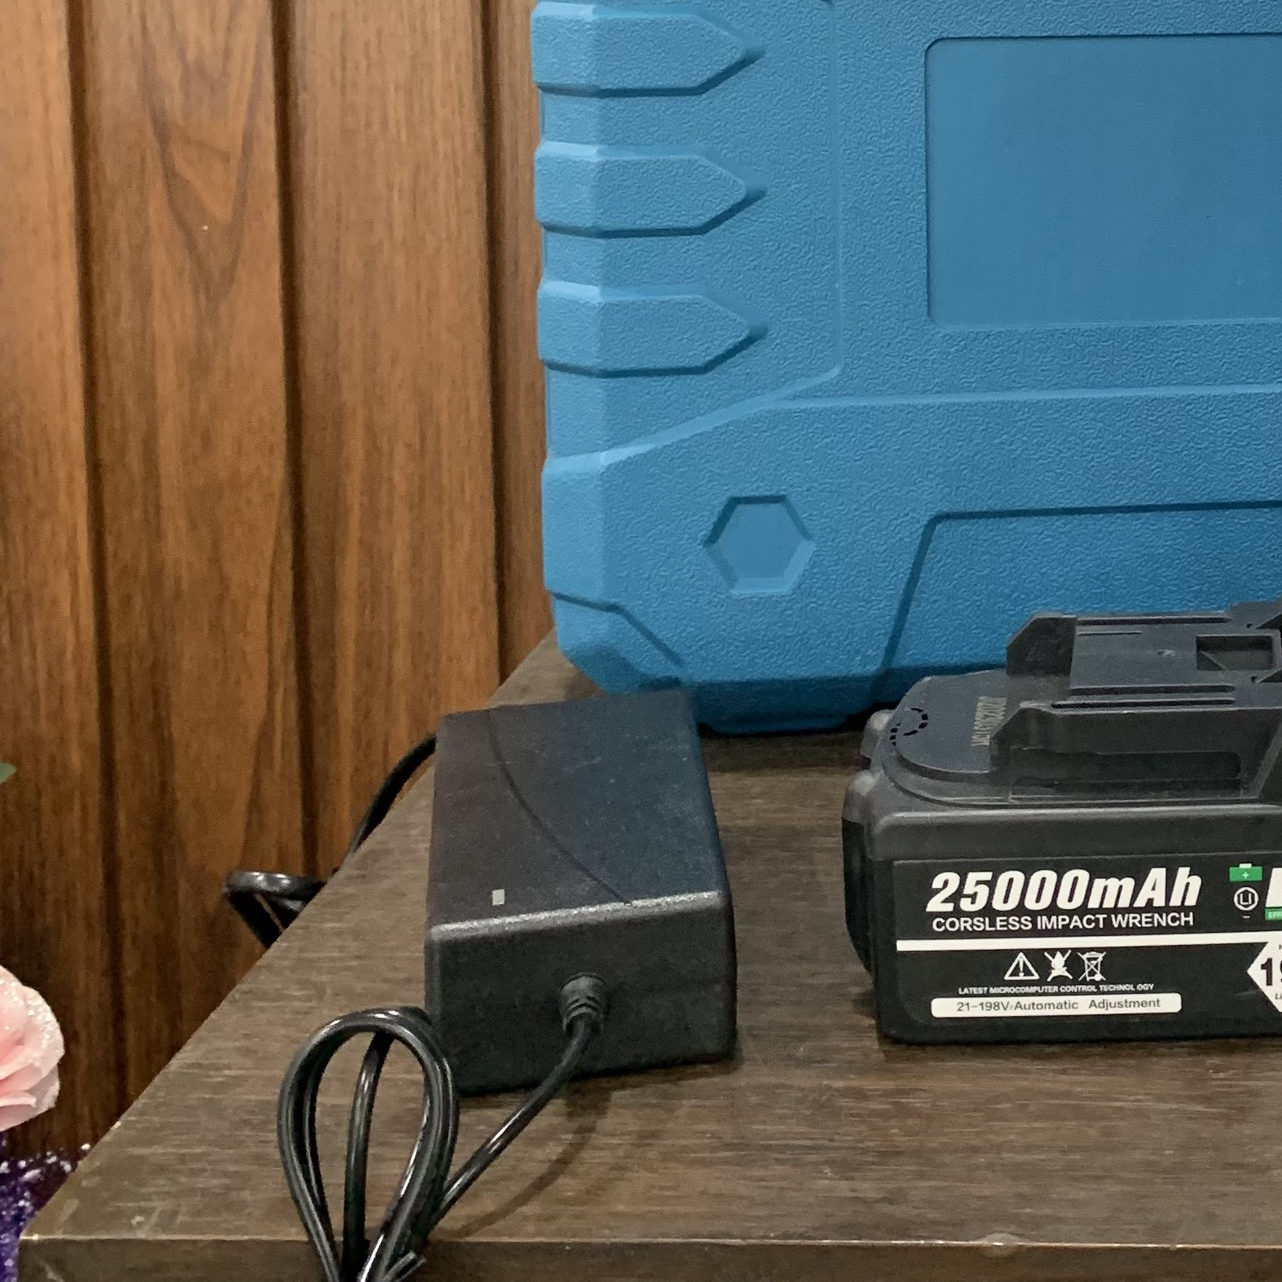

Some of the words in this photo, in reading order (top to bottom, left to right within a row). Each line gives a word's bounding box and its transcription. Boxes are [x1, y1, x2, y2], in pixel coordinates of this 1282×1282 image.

[926, 866, 1202, 912] 25000mAh
[932, 915, 1033, 932] CORSLESS
[1037, 913, 1108, 930] IMPACT
[1112, 912, 1194, 929] WRENCH
[958, 987, 988, 995] LATEST
[989, 985, 1059, 994] MICROCOMPUTER
[1059, 984, 1098, 993] CONTROL
[1088, 999, 1161, 1010] Adjustment
